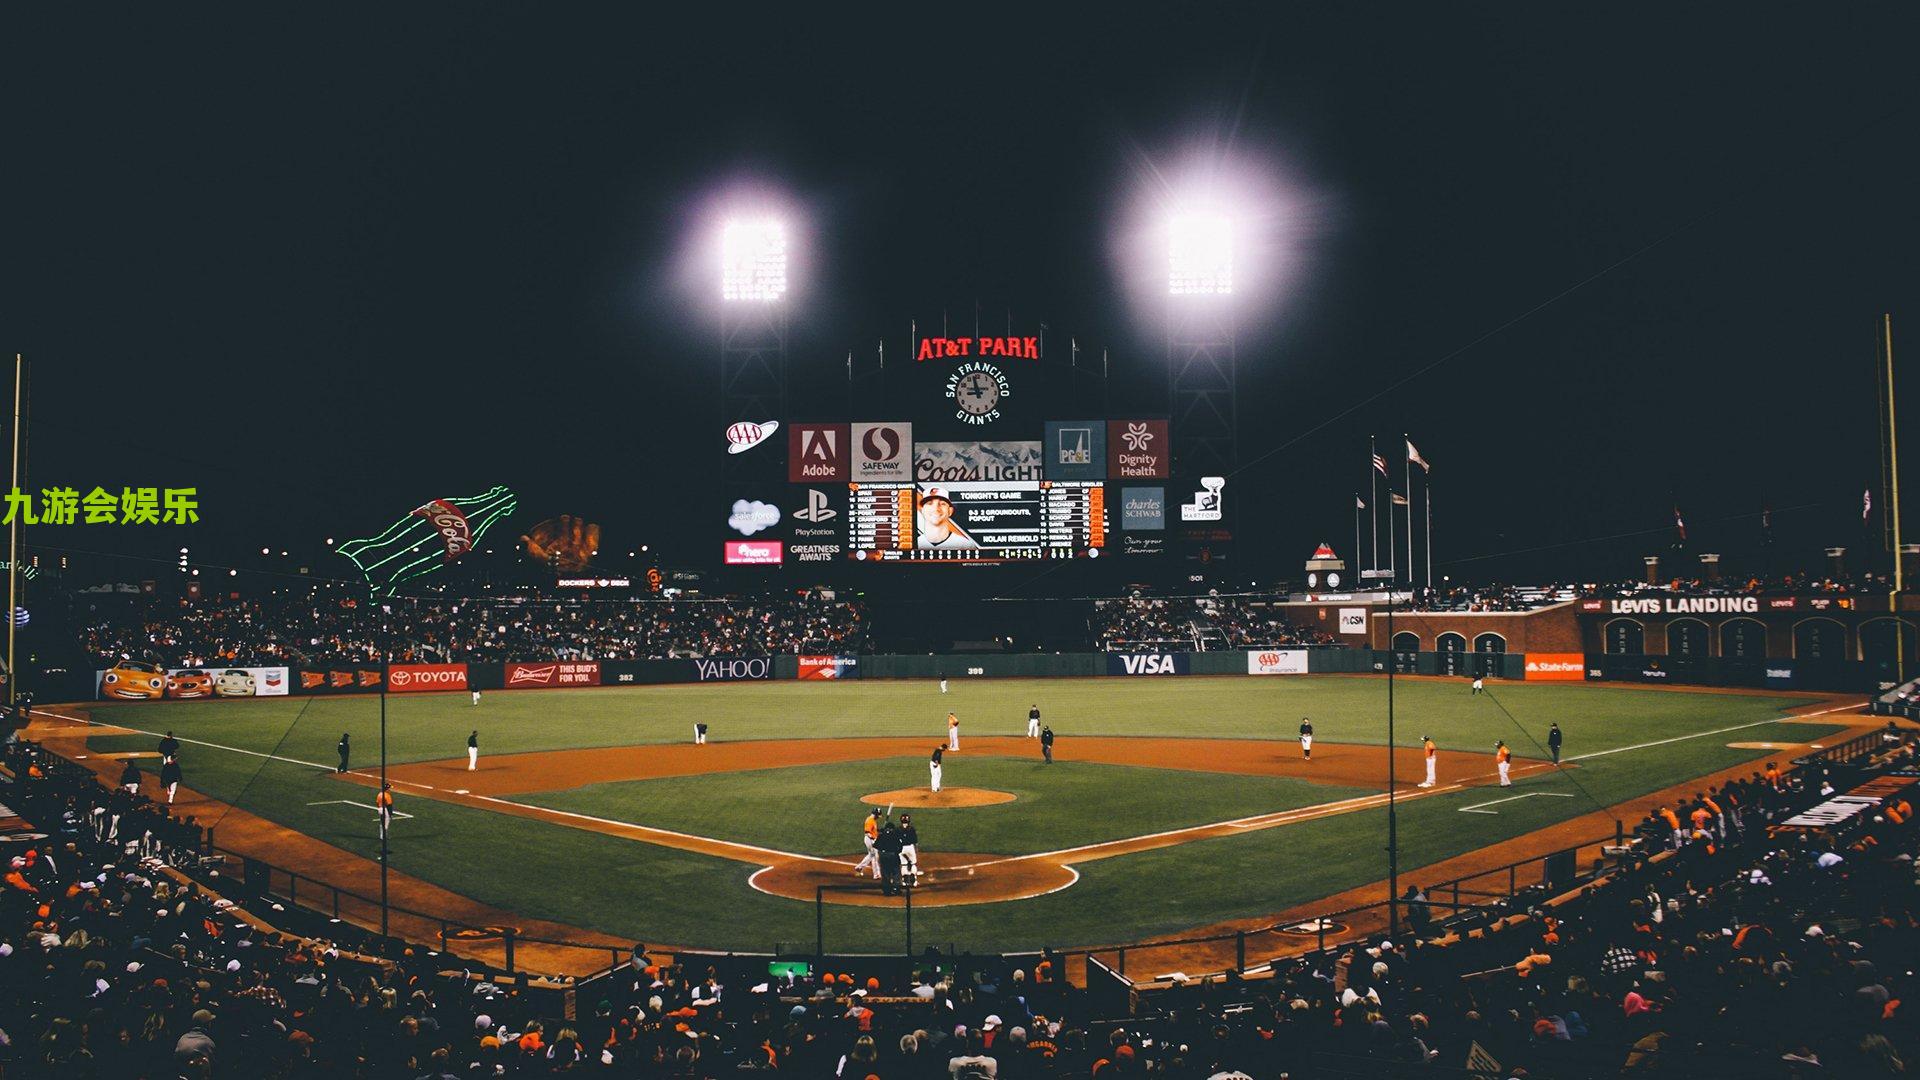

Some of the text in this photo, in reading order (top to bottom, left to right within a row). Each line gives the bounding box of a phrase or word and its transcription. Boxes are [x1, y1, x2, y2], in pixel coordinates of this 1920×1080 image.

[918, 337, 1038, 360] AT&T PARK
[946, 362, 1010, 398] SAN FRANCISCO
[956, 408, 1001, 425] GIANTS
[1061, 450, 1090, 462] PG&E
[1119, 454, 1156, 466] Dignity
[802, 464, 836, 476] Adobe
[915, 459, 1042, 482] Coors LIGHT
[1121, 466, 1156, 476] Health
[1126, 499, 1160, 509] charles
[796, 529, 834, 537] PlayStation
[790, 545, 840, 553] GREATNESS
[799, 553, 832, 561] AWAITS
[1666, 597, 1758, 612] LANDING
[1350, 616, 1364, 625] CSN
[559, 665, 597, 673] THIS BUD'S
[696, 658, 770, 680] YAHOO!
[1119, 655, 1176, 674] VISA
[413, 671, 466, 682] TOYOTA
[515, 670, 551, 679] Budweiser
[559, 674, 590, 682] FOR YOU.
